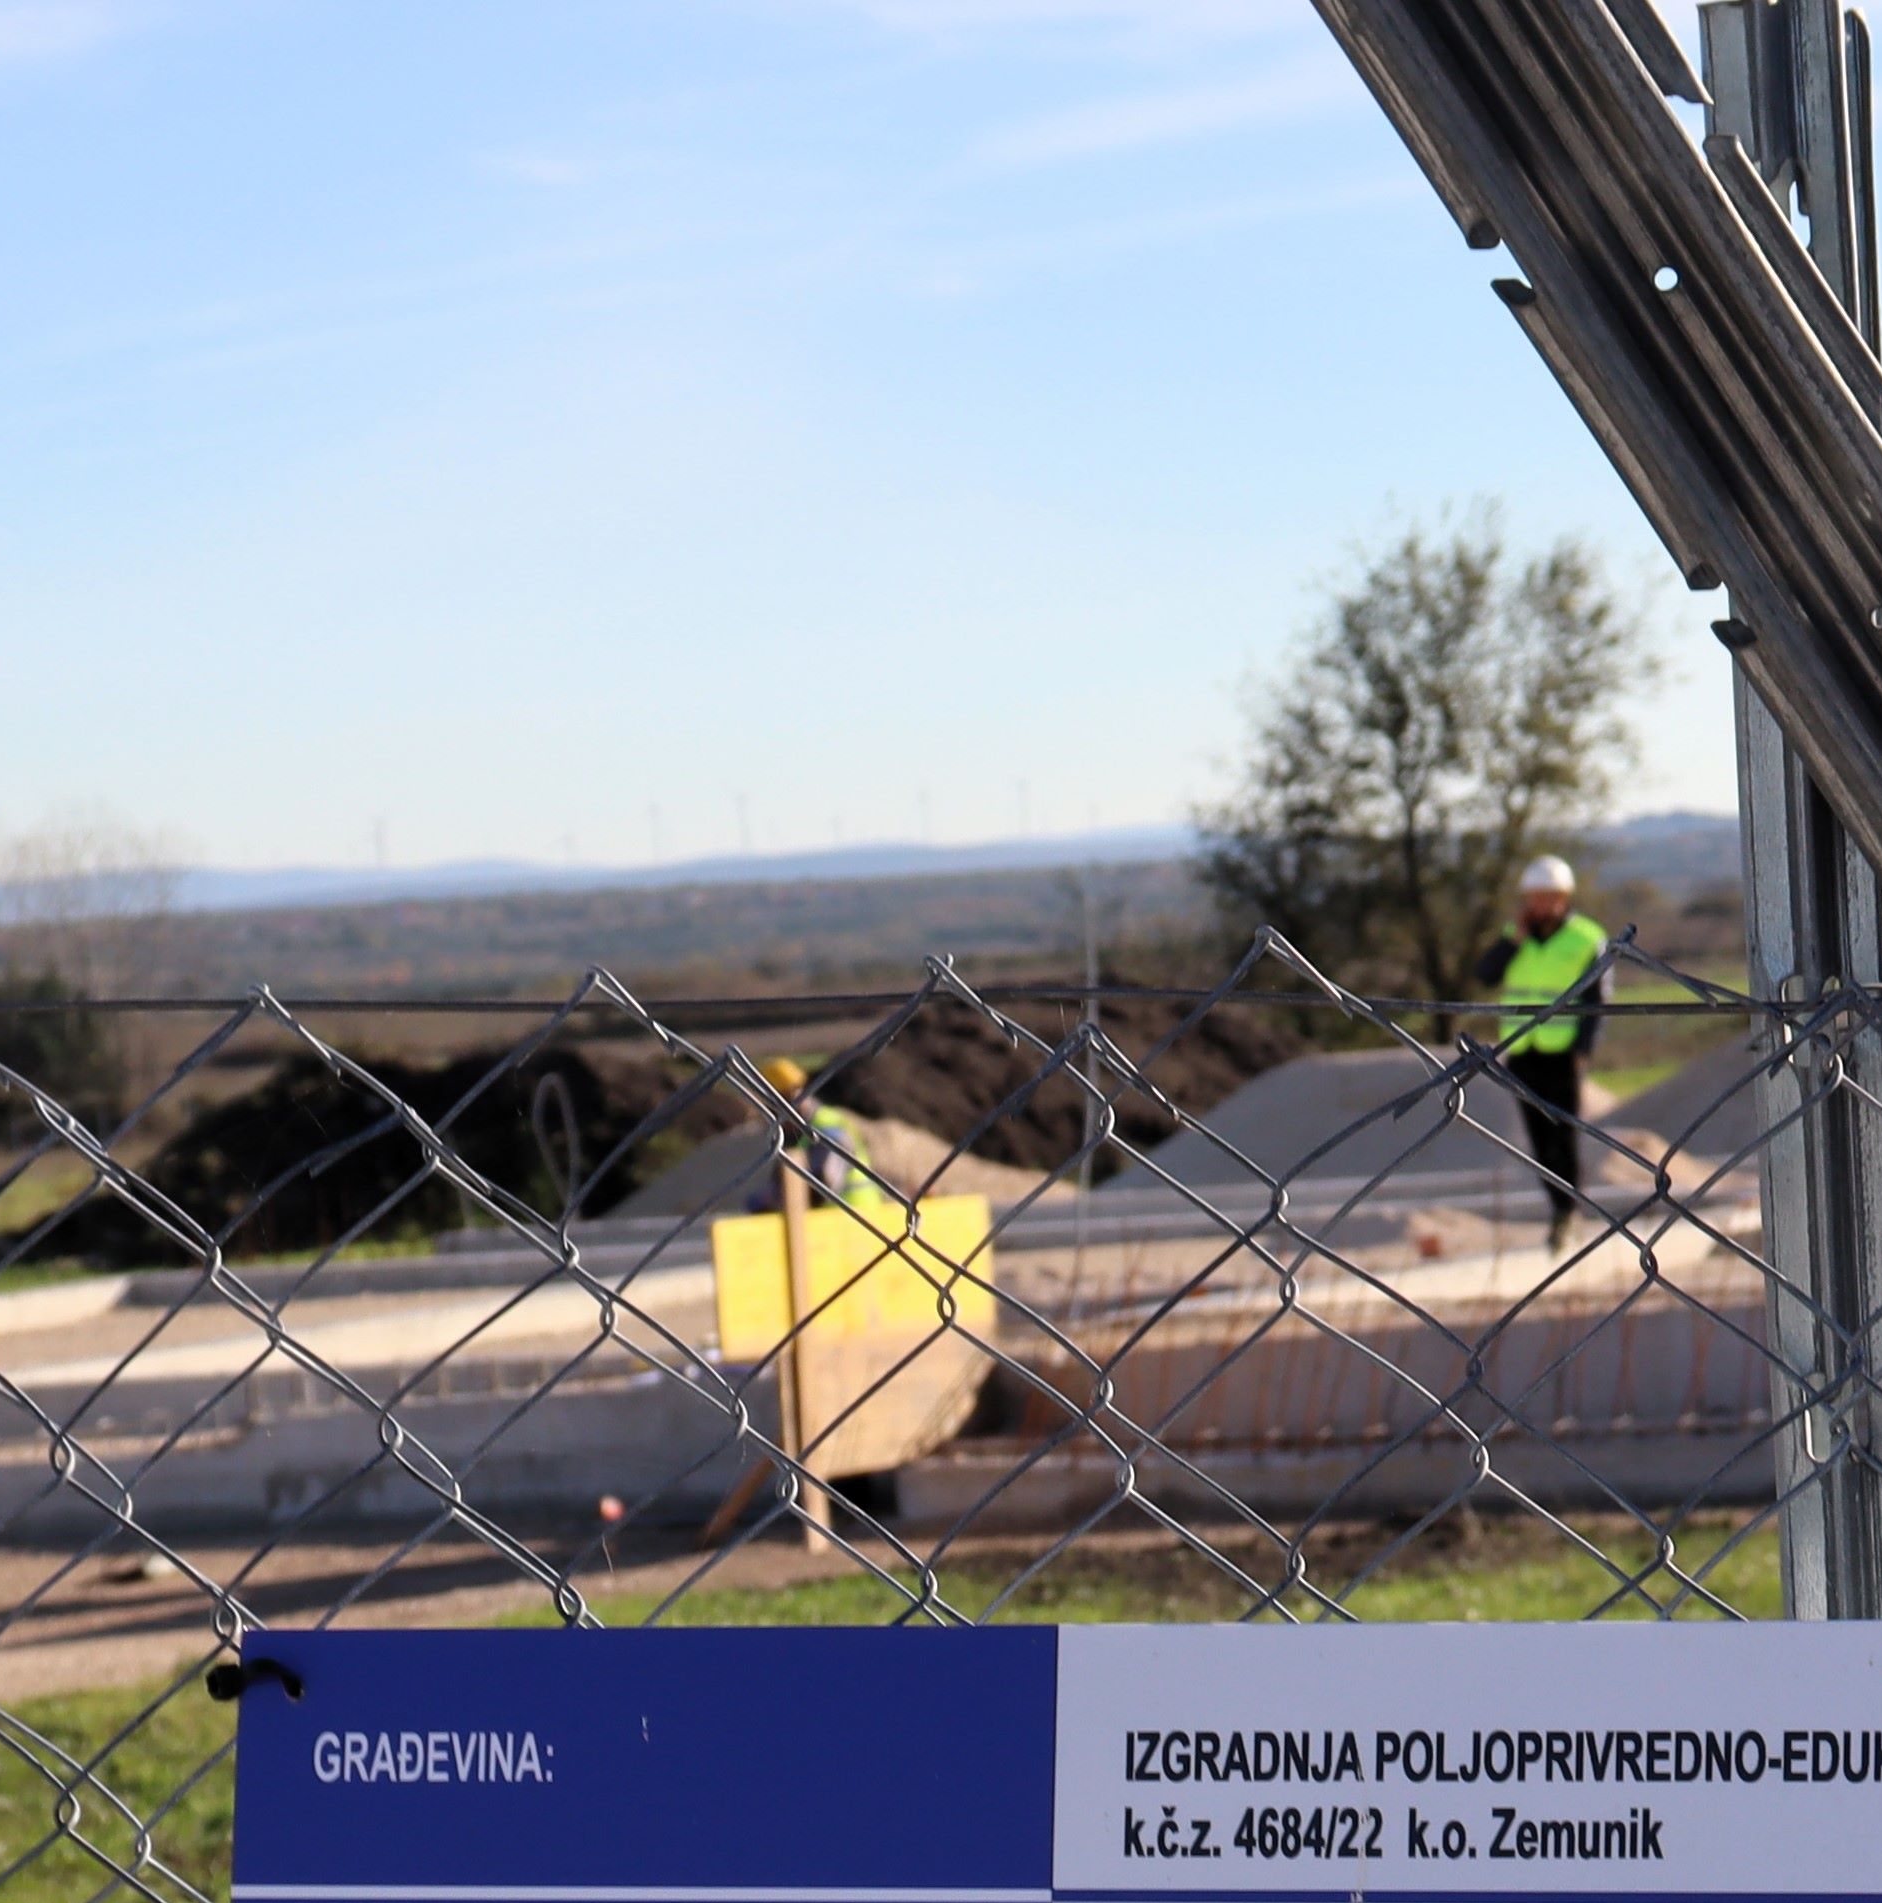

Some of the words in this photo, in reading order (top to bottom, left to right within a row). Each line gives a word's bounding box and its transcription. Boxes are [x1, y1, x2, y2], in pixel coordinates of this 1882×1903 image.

[313, 1731, 554, 1783] GRAĐEVINA:
[1125, 1731, 1362, 1783] IZGRADNJA
[1124, 1806, 1221, 1858] k.č.z.
[1233, 1806, 1383, 1859] 4684/22
[1408, 1807, 1477, 1860] k.o.
[1489, 1807, 1664, 1860] Zemunik
